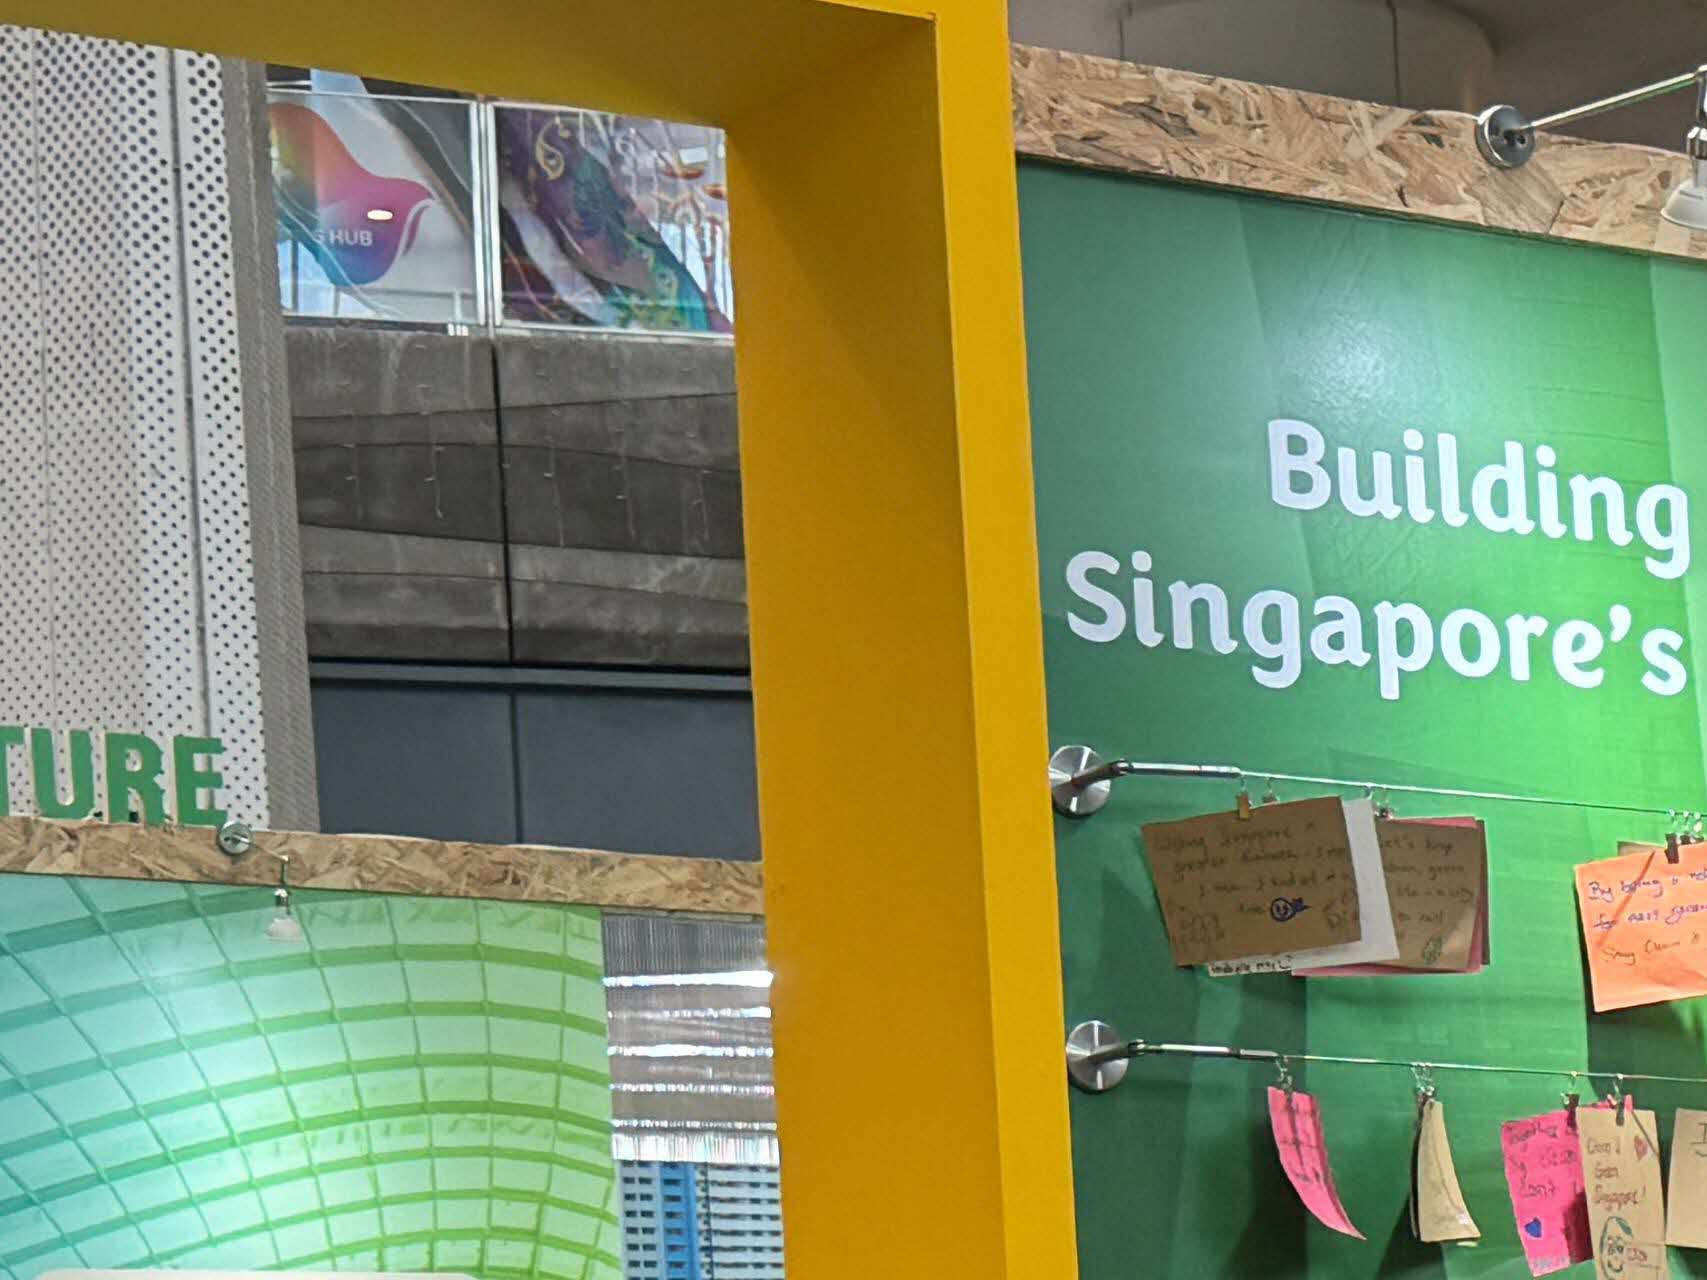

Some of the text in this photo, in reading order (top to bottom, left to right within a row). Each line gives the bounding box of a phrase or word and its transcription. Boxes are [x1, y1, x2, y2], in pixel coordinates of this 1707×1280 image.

[329, 229, 374, 246] HUB
[1268, 419, 1690, 579] Building
[1066, 550, 1687, 698] Singapore's
